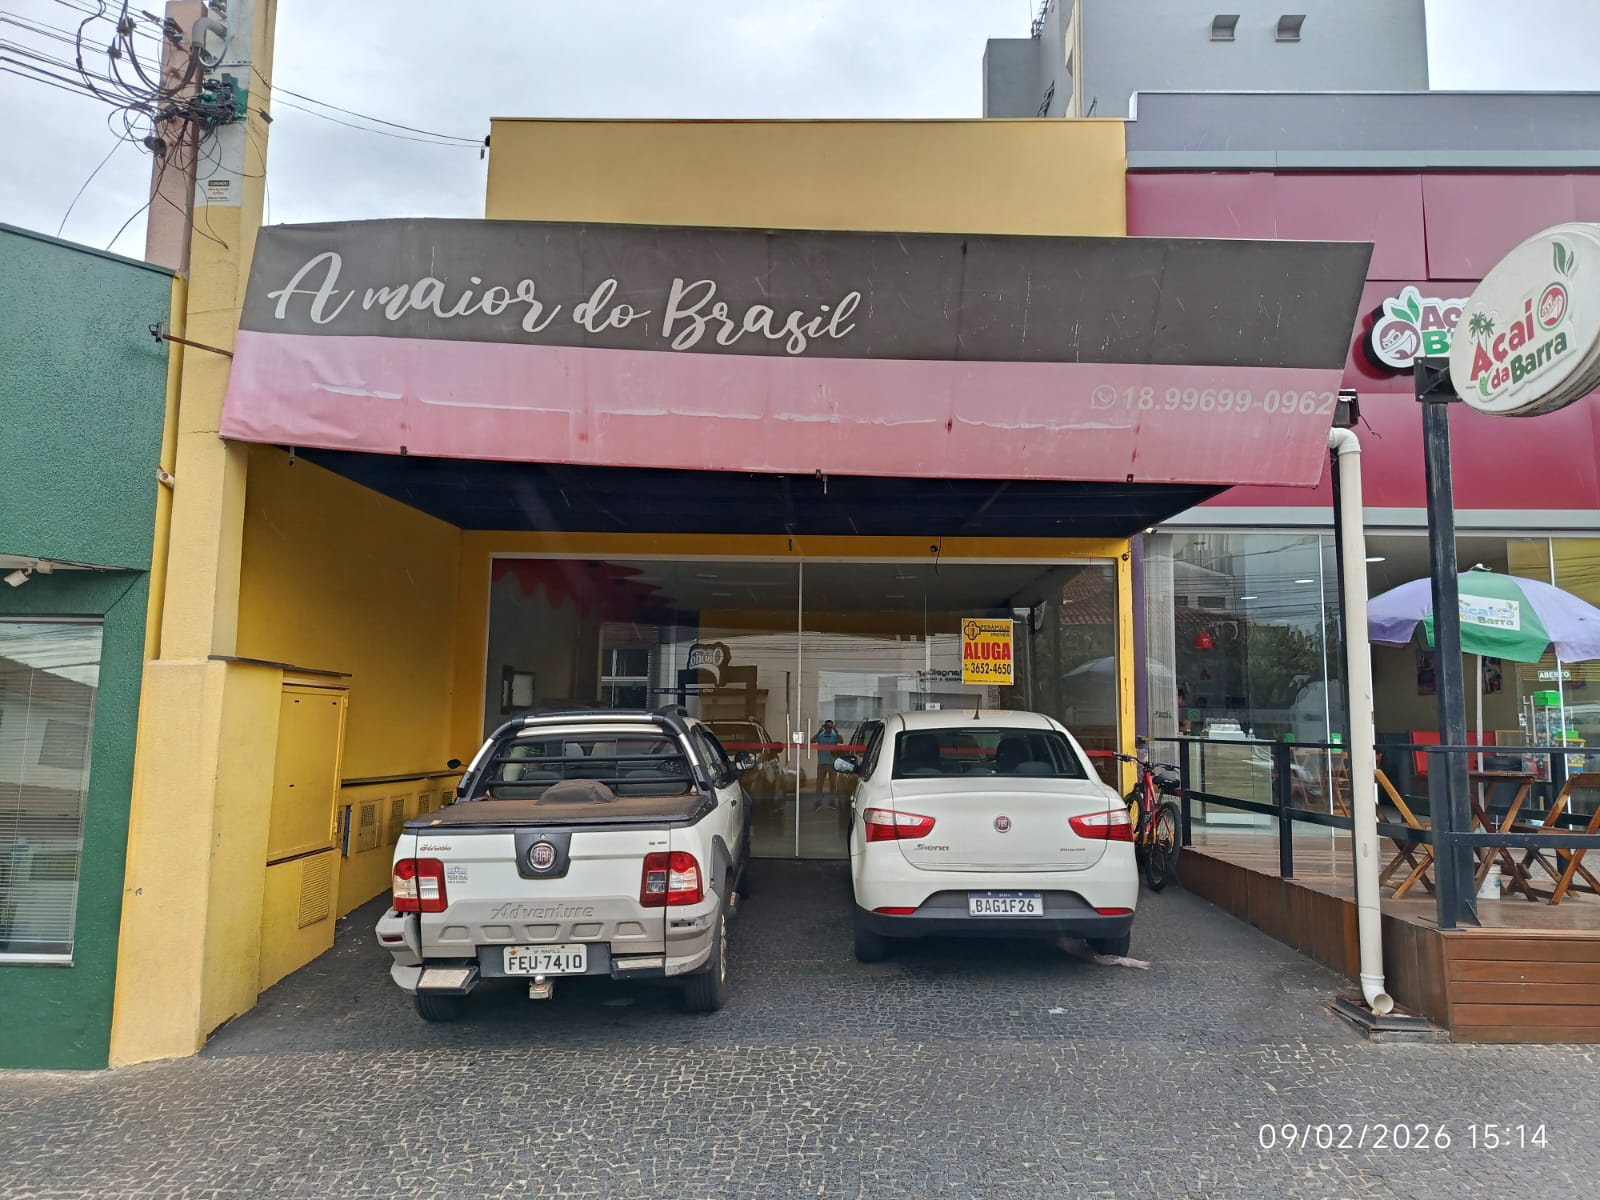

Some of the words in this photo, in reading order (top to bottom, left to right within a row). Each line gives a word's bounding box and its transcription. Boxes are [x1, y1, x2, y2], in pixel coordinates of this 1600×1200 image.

[268, 252, 354, 324] A
[363, 276, 561, 334] maior
[573, 278, 651, 333] do
[662, 278, 861, 355] Brasil
[1491, 366, 1511, 390] da
[1510, 332, 1568, 385] Barra
[1122, 386, 1335, 415] 18.99699-0962
[1477, 616, 1515, 627] Barra
[964, 642, 1012, 661] ALUGA
[971, 662, 1012, 675] 3652-4650
[534, 850, 551, 862] FIAT
[491, 902, 595, 920] Adventure
[975, 899, 1035, 913] BAG1F26
